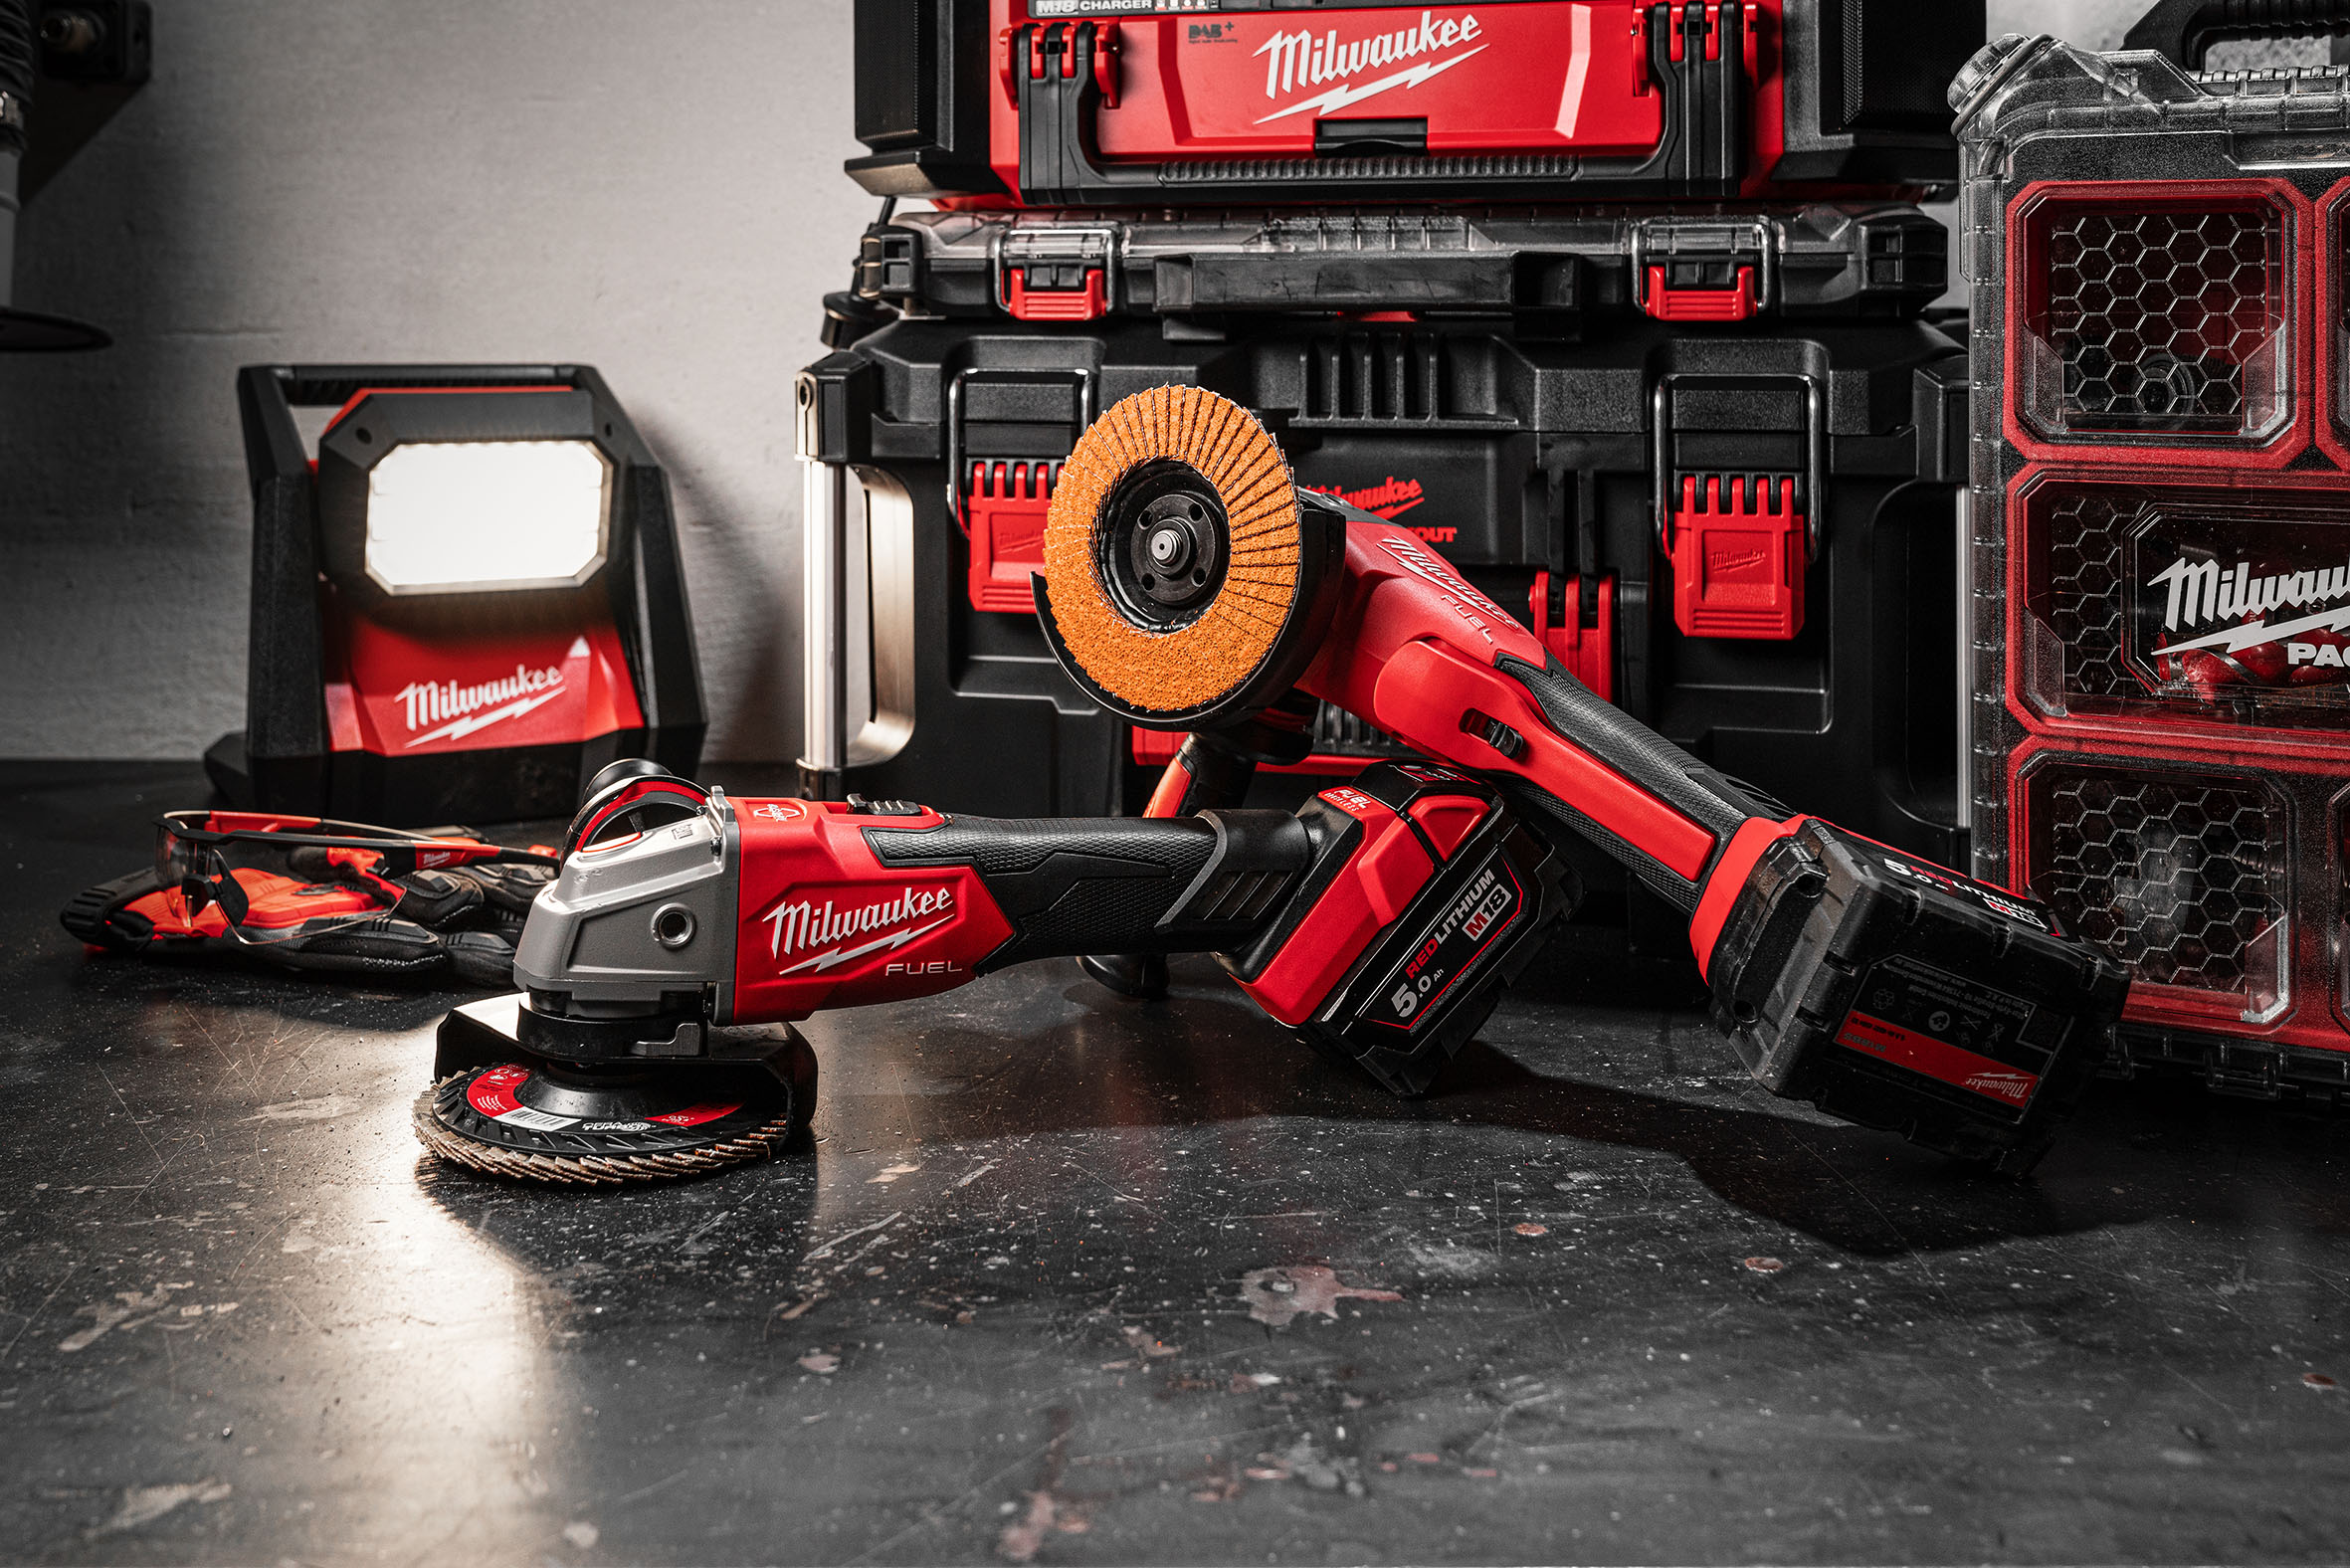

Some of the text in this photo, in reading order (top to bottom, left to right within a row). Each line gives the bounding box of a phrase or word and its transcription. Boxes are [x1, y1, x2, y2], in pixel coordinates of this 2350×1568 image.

[1079, 0, 1152, 11] CHARGER
[1252, 11, 1482, 100] Milwaukee
[1381, 534, 1520, 631] Milwaukee
[2147, 557, 2350, 633] Milwau
[1441, 594, 1493, 645] FUEL
[2288, 643, 2350, 668] PA
[395, 664, 564, 731] Milwaukee
[1333, 789, 1372, 810] FUEL
[1883, 858, 1933, 883] 5.0
[762, 886, 954, 959] Milwaukee
[1405, 869, 1495, 980] REDLITHIUM
[1464, 886, 1508, 939] M18
[884, 960, 963, 976] FUEL
[1391, 968, 1445, 1018] 5.0 Ah
[1965, 1078, 2029, 1099] Milwaukee
